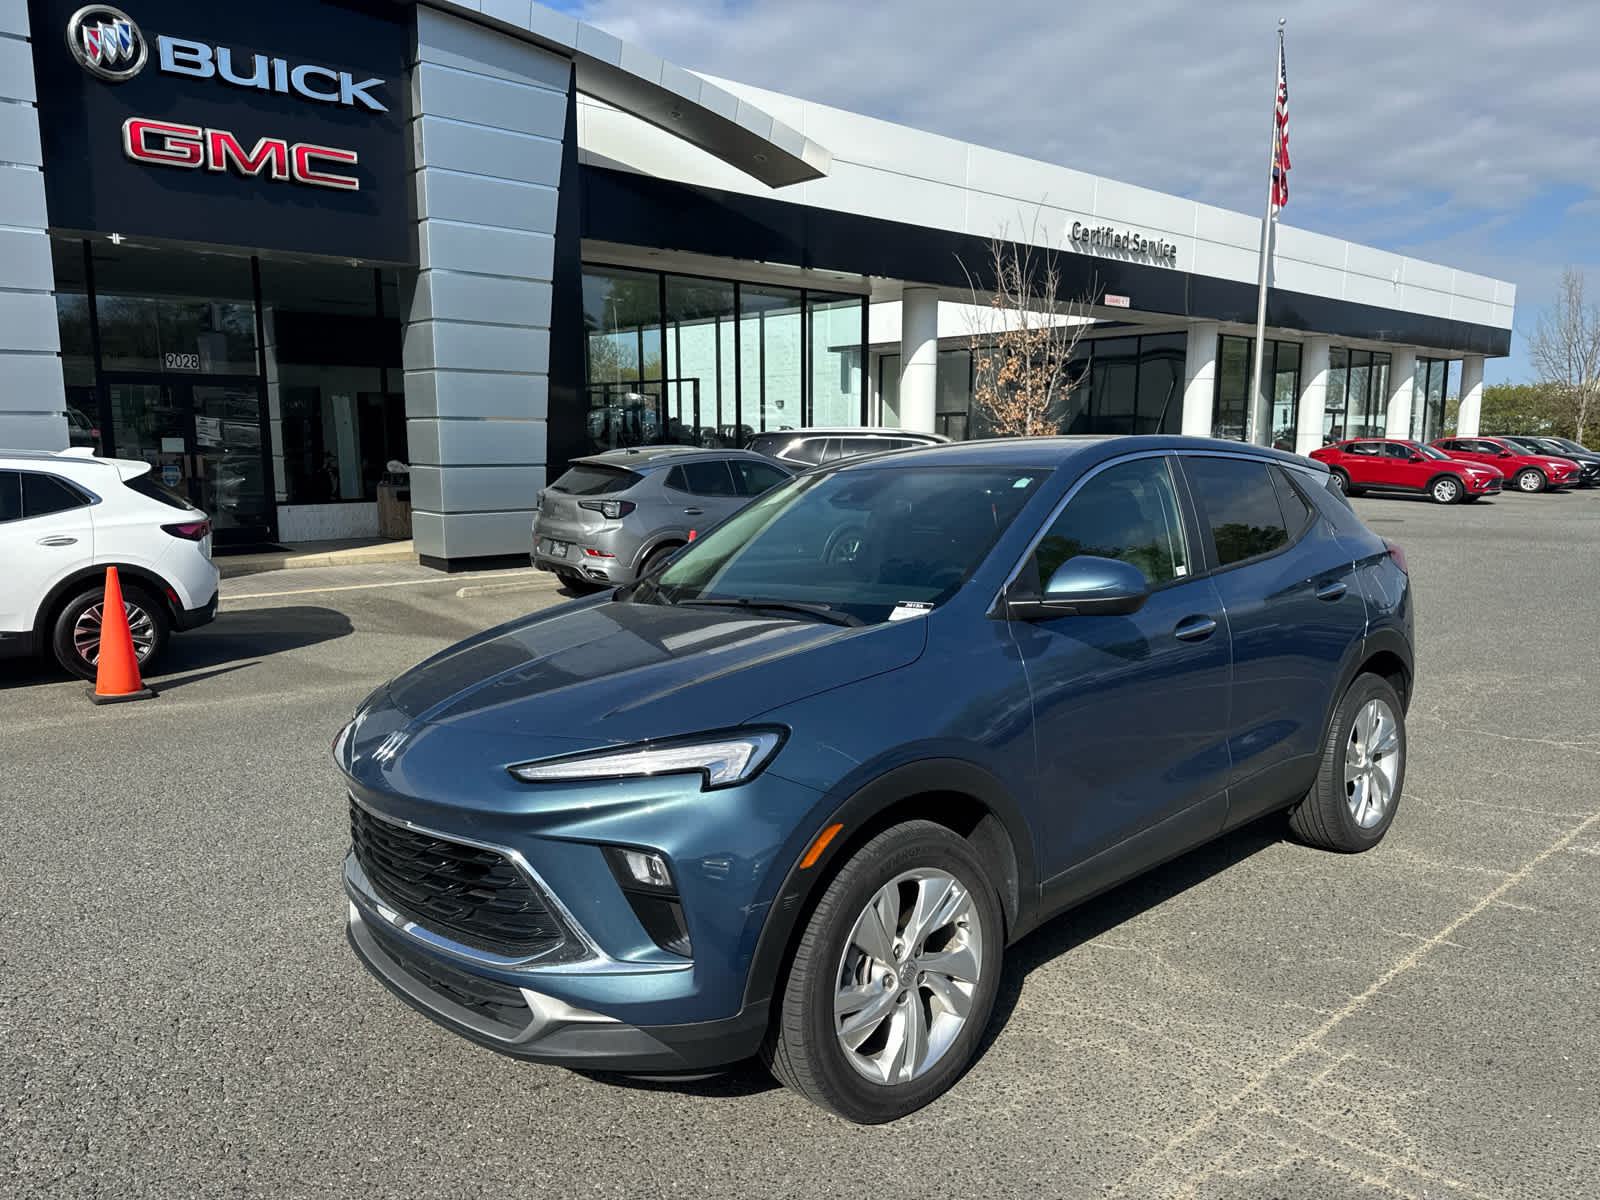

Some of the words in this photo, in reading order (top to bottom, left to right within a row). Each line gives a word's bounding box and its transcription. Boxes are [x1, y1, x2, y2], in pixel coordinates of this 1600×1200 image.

[157, 35, 389, 112] BUICK
[122, 117, 360, 190] GMC
[1072, 221, 1130, 249] Certified
[1133, 233, 1177, 258] Service
[166, 353, 199, 369] 9028
